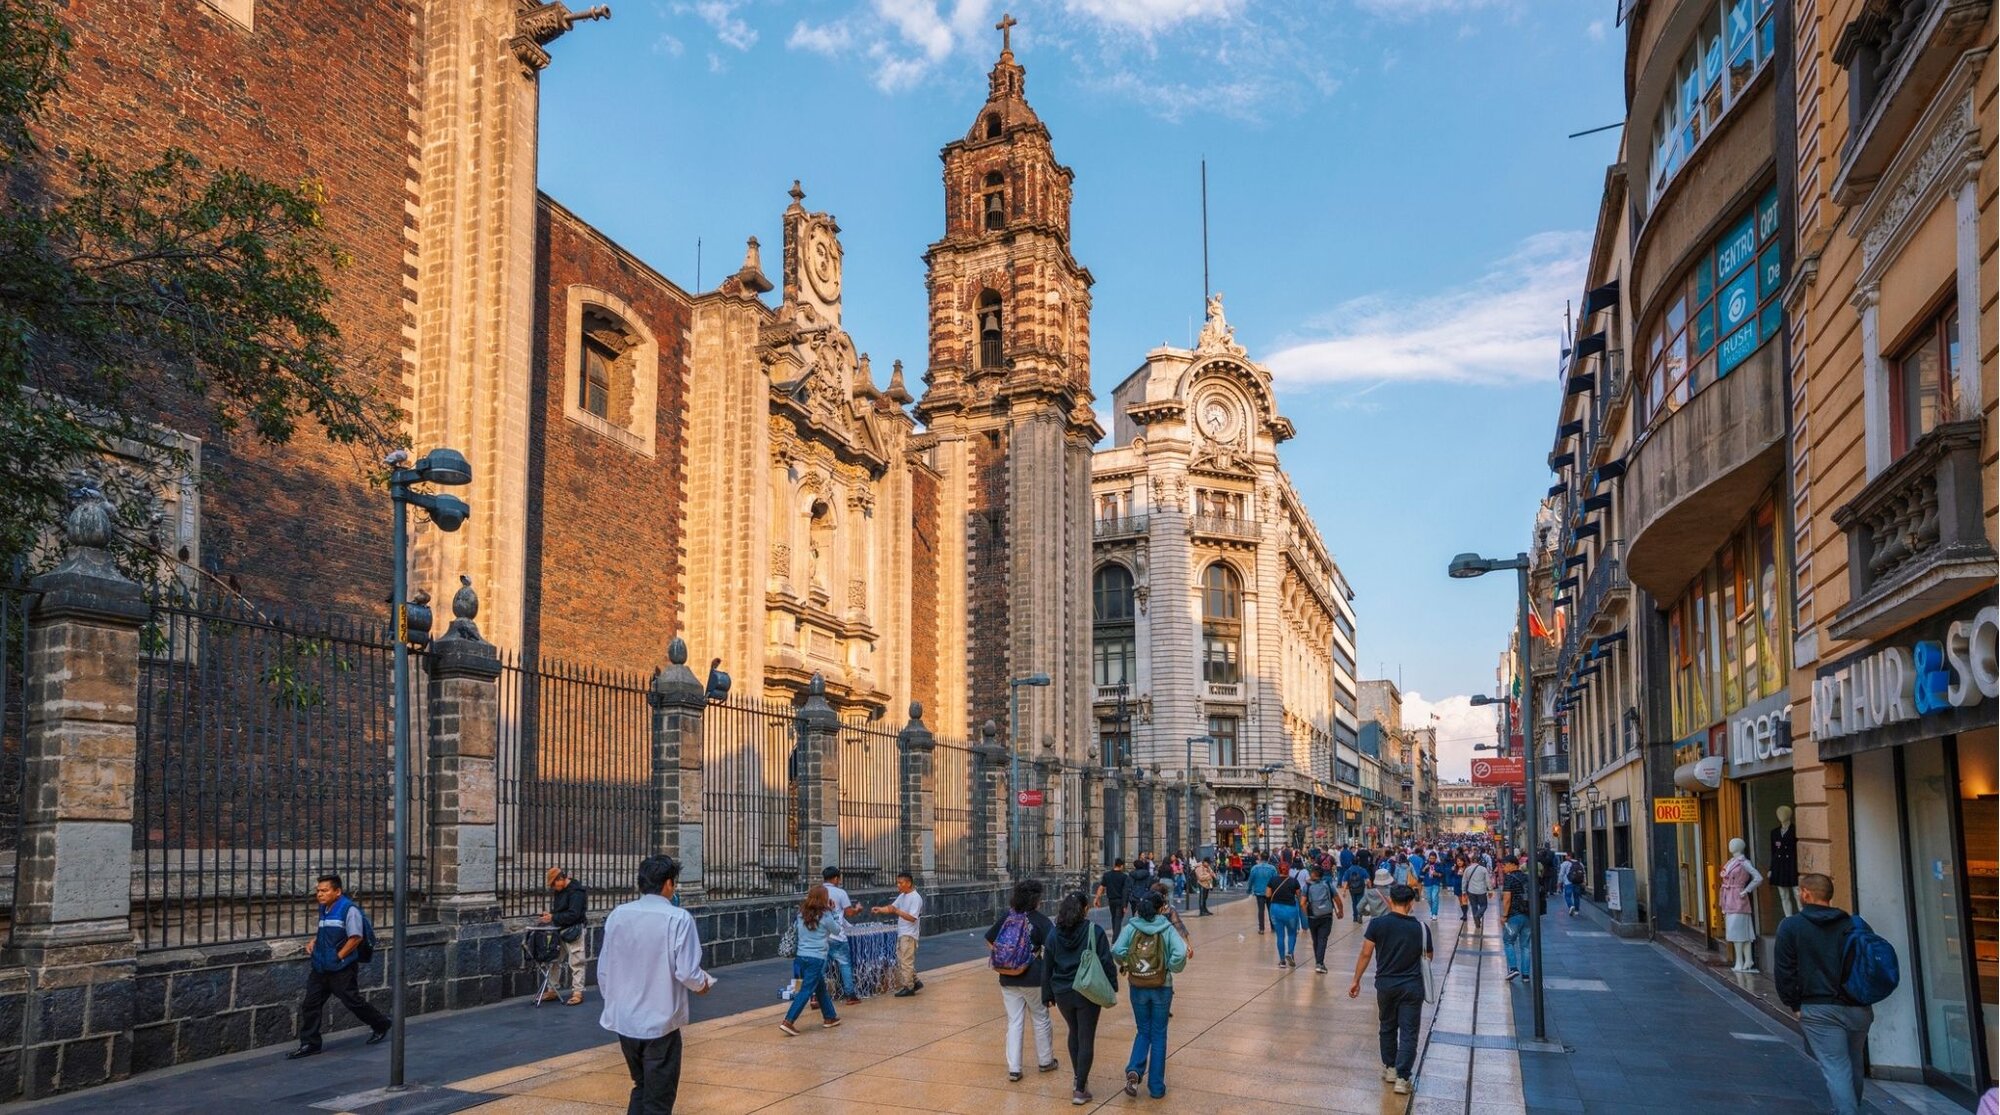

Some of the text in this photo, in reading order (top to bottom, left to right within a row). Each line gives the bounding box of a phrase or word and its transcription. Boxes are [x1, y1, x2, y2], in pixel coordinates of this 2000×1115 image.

[1718, 200, 1778, 278] CENTRO OPT
[1767, 263, 1780, 285] De
[1723, 323, 1753, 357] RUSH
[1810, 646, 1919, 742] ARTHUR
[1914, 640, 1950, 715] &
[1656, 805, 1681, 820] ORO
